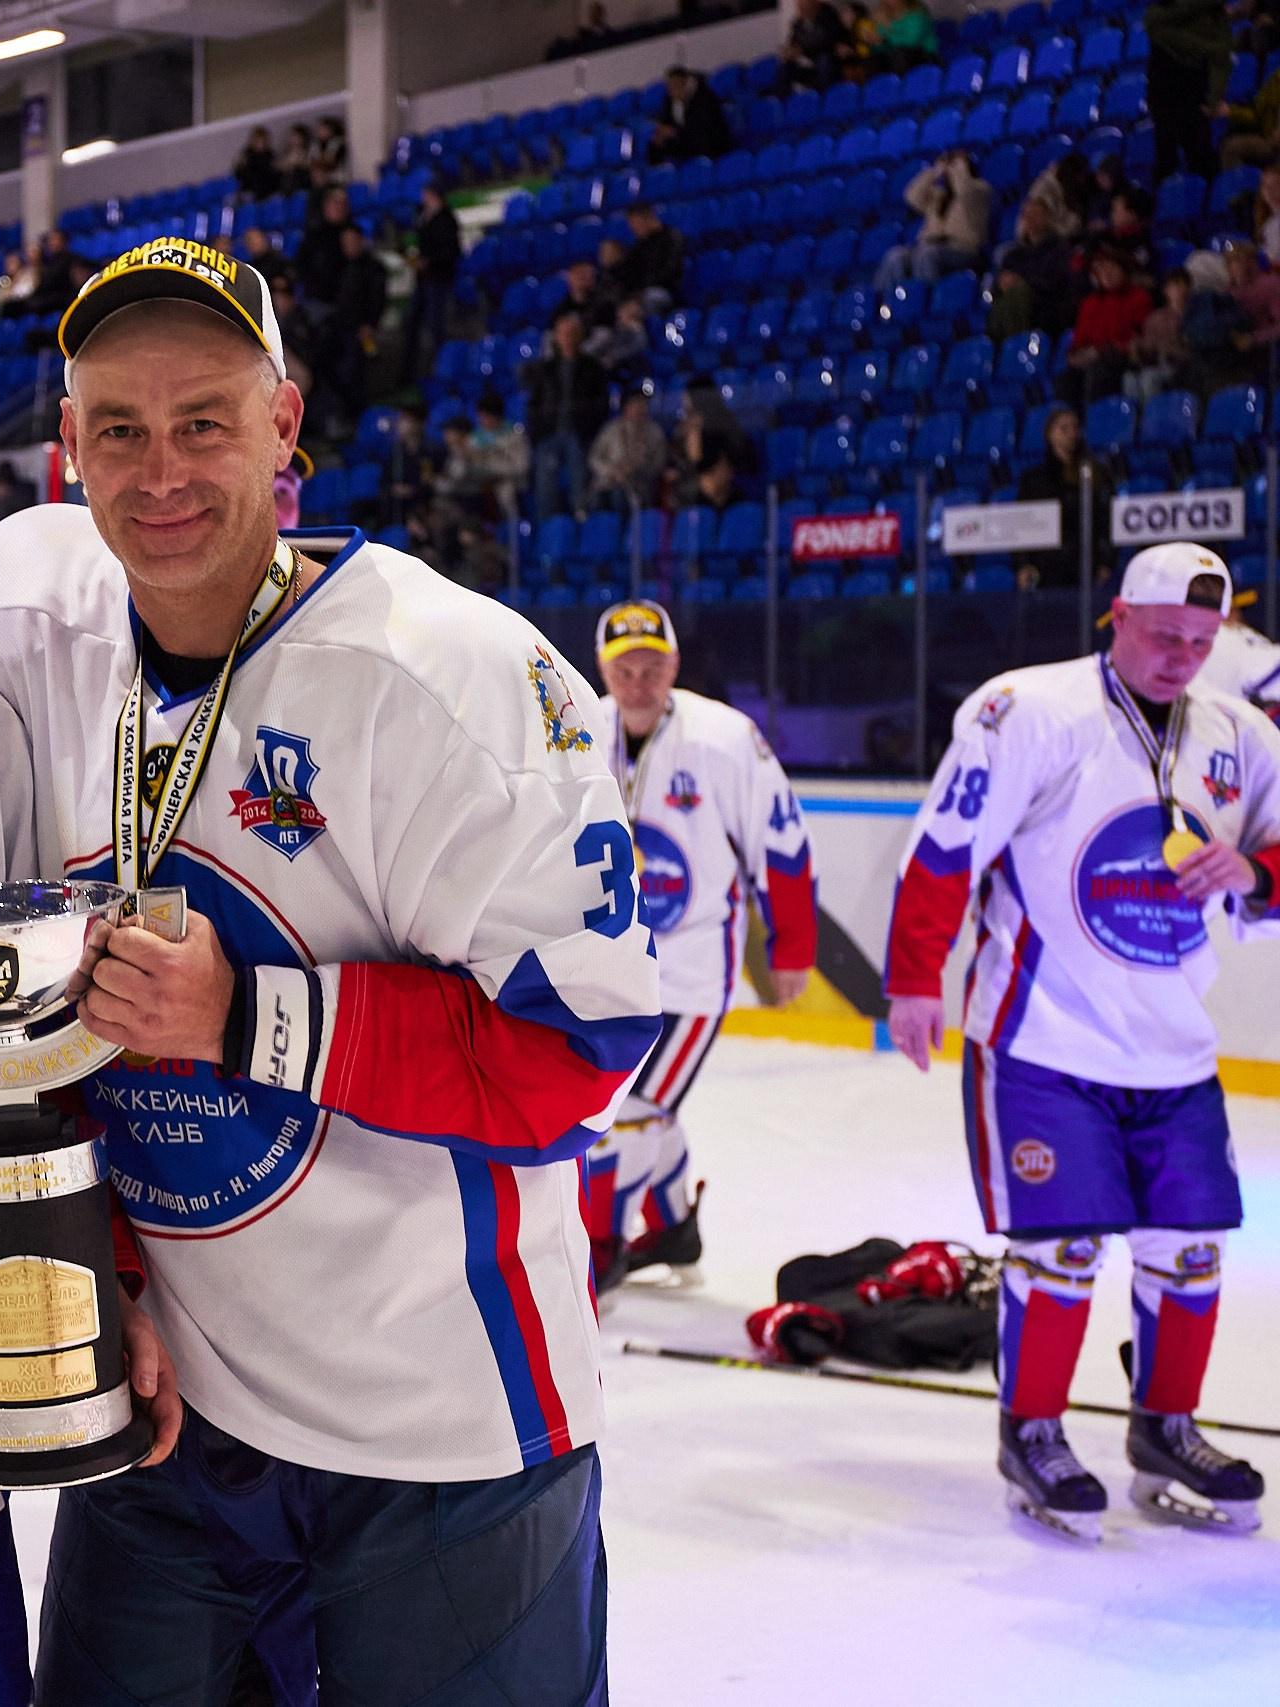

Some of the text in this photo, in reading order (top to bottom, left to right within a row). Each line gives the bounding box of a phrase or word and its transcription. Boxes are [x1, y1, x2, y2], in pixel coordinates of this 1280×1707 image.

[793, 518, 899, 556] FONBET
[121, 724, 135, 815] ХОККЕЙНАЯ
[151, 742, 197, 856] ОФИЦЕРСКАЯ
[243, 806, 267, 820] 2014
[121, 822, 133, 865] ЛИГА
[279, 831, 300, 844] ЛЕТ
[128, 1121, 204, 1144] КЛУБ
[148, 1185, 189, 1215] УМВД
[189, 1194, 210, 1211] по
[229, 1176, 251, 1196] Н.
[248, 1116, 302, 1182] Новгород
[20, 1360, 42, 1376] ХК
